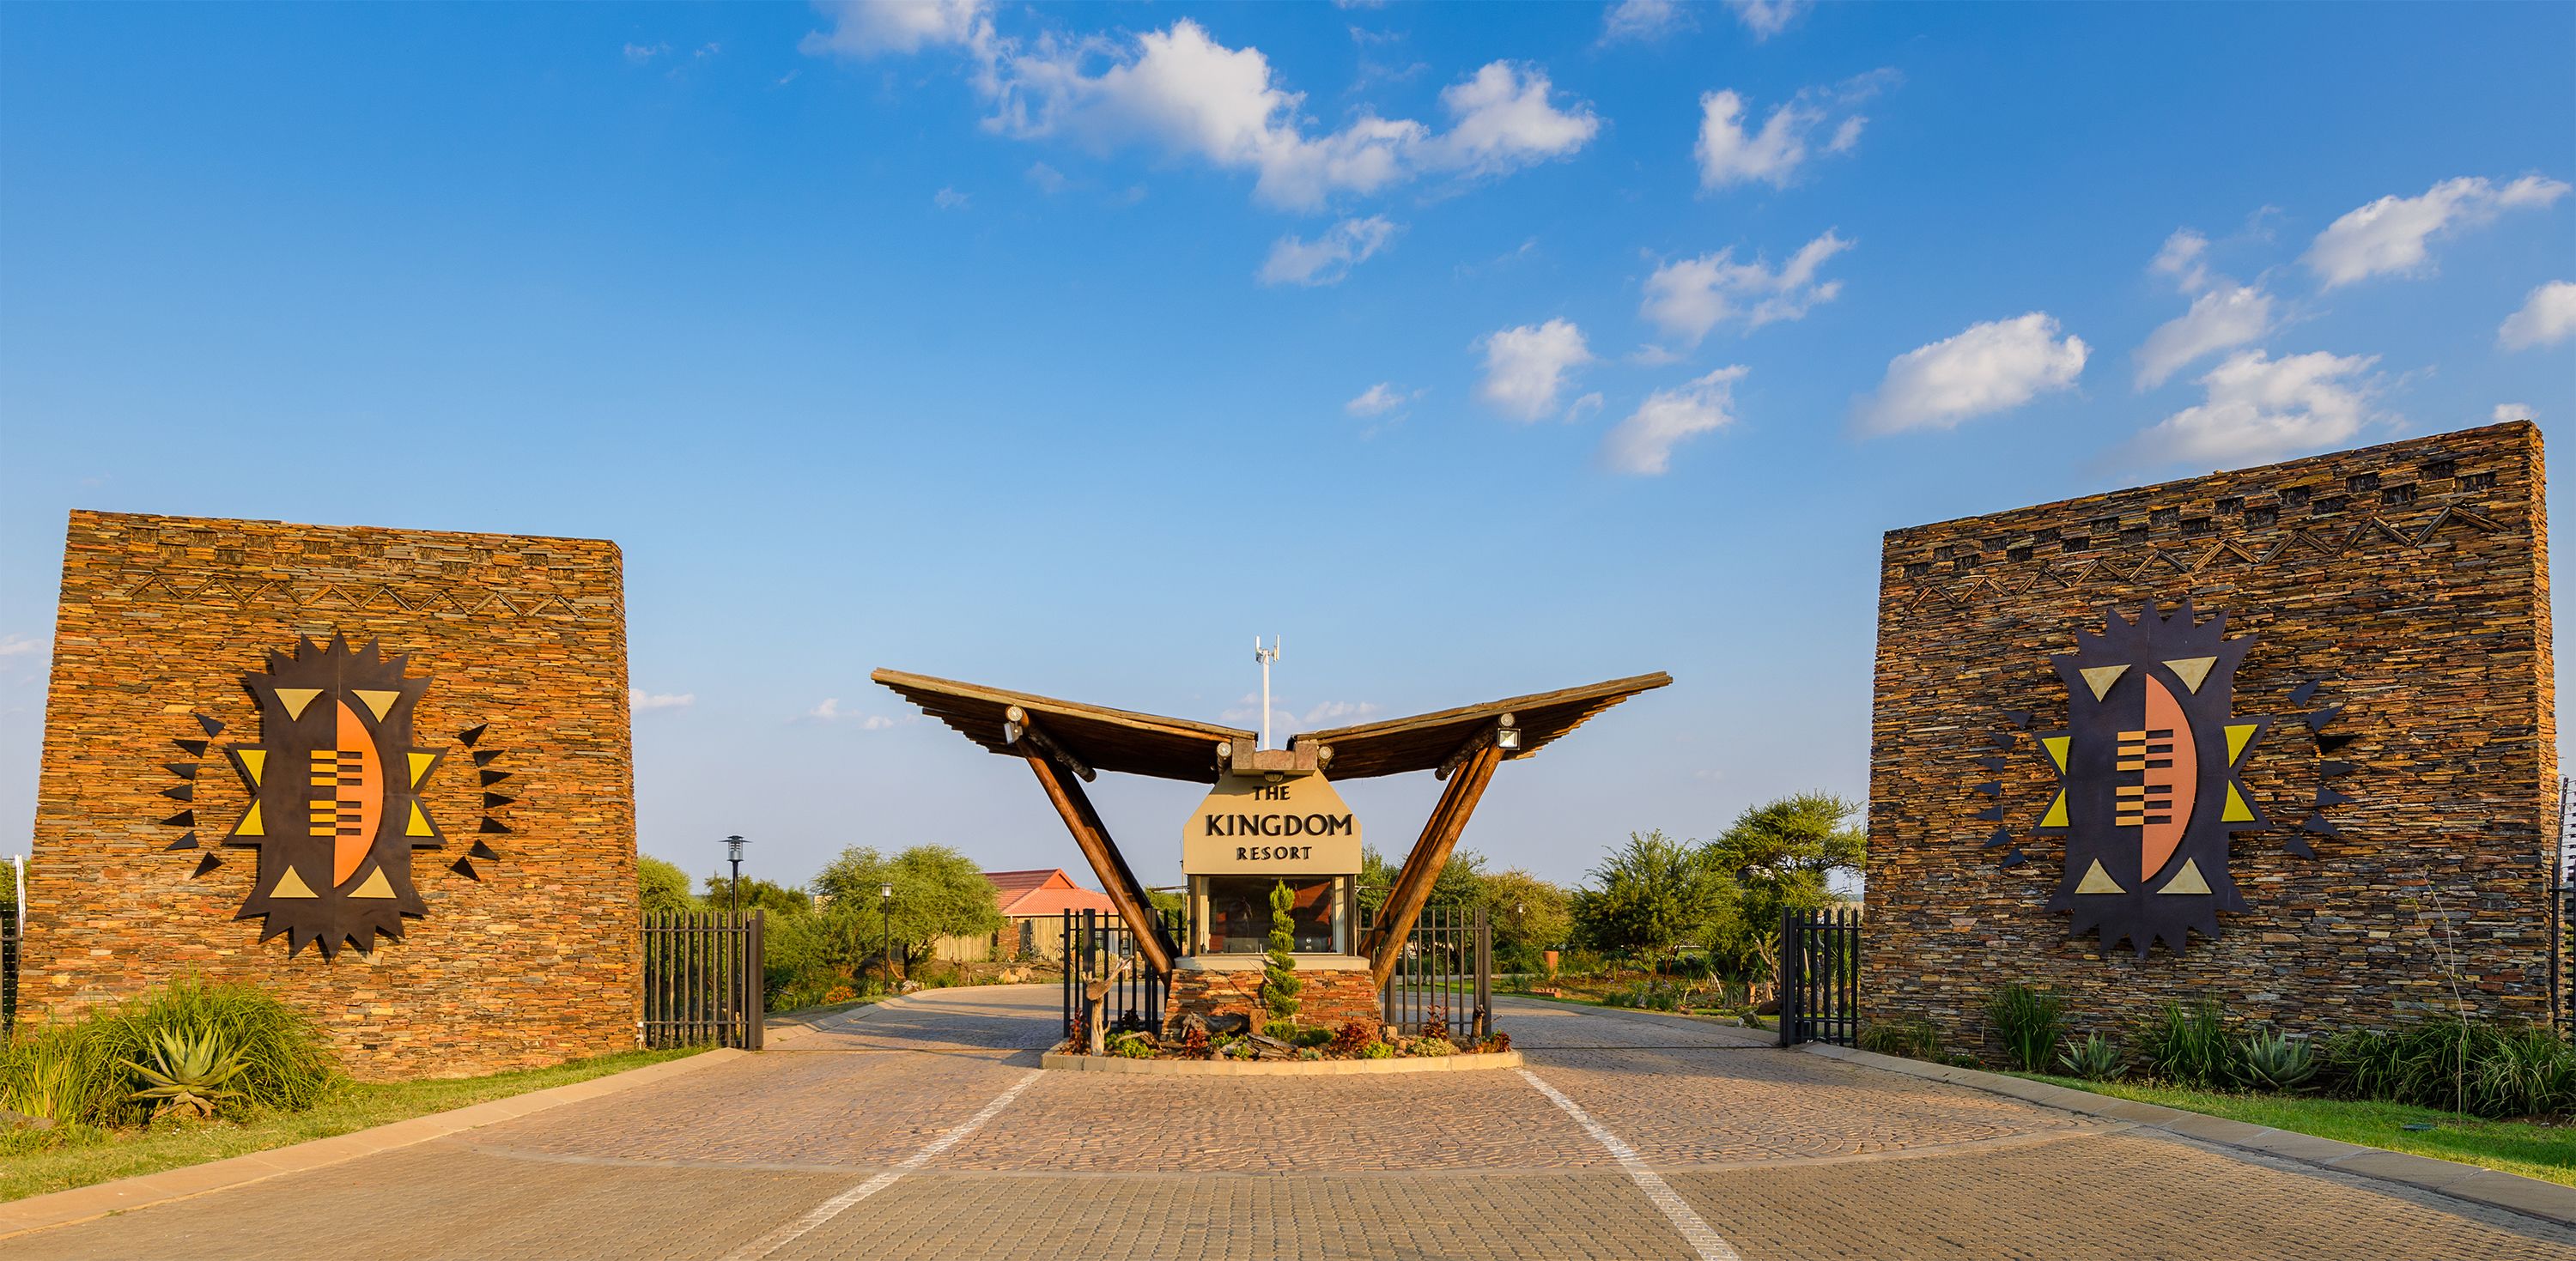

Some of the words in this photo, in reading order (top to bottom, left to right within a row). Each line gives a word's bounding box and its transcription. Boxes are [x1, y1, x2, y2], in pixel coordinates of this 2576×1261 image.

[1252, 785, 1291, 801] THE
[1205, 814, 1353, 836] KINGDOM
[1236, 846, 1313, 860] RESORT
